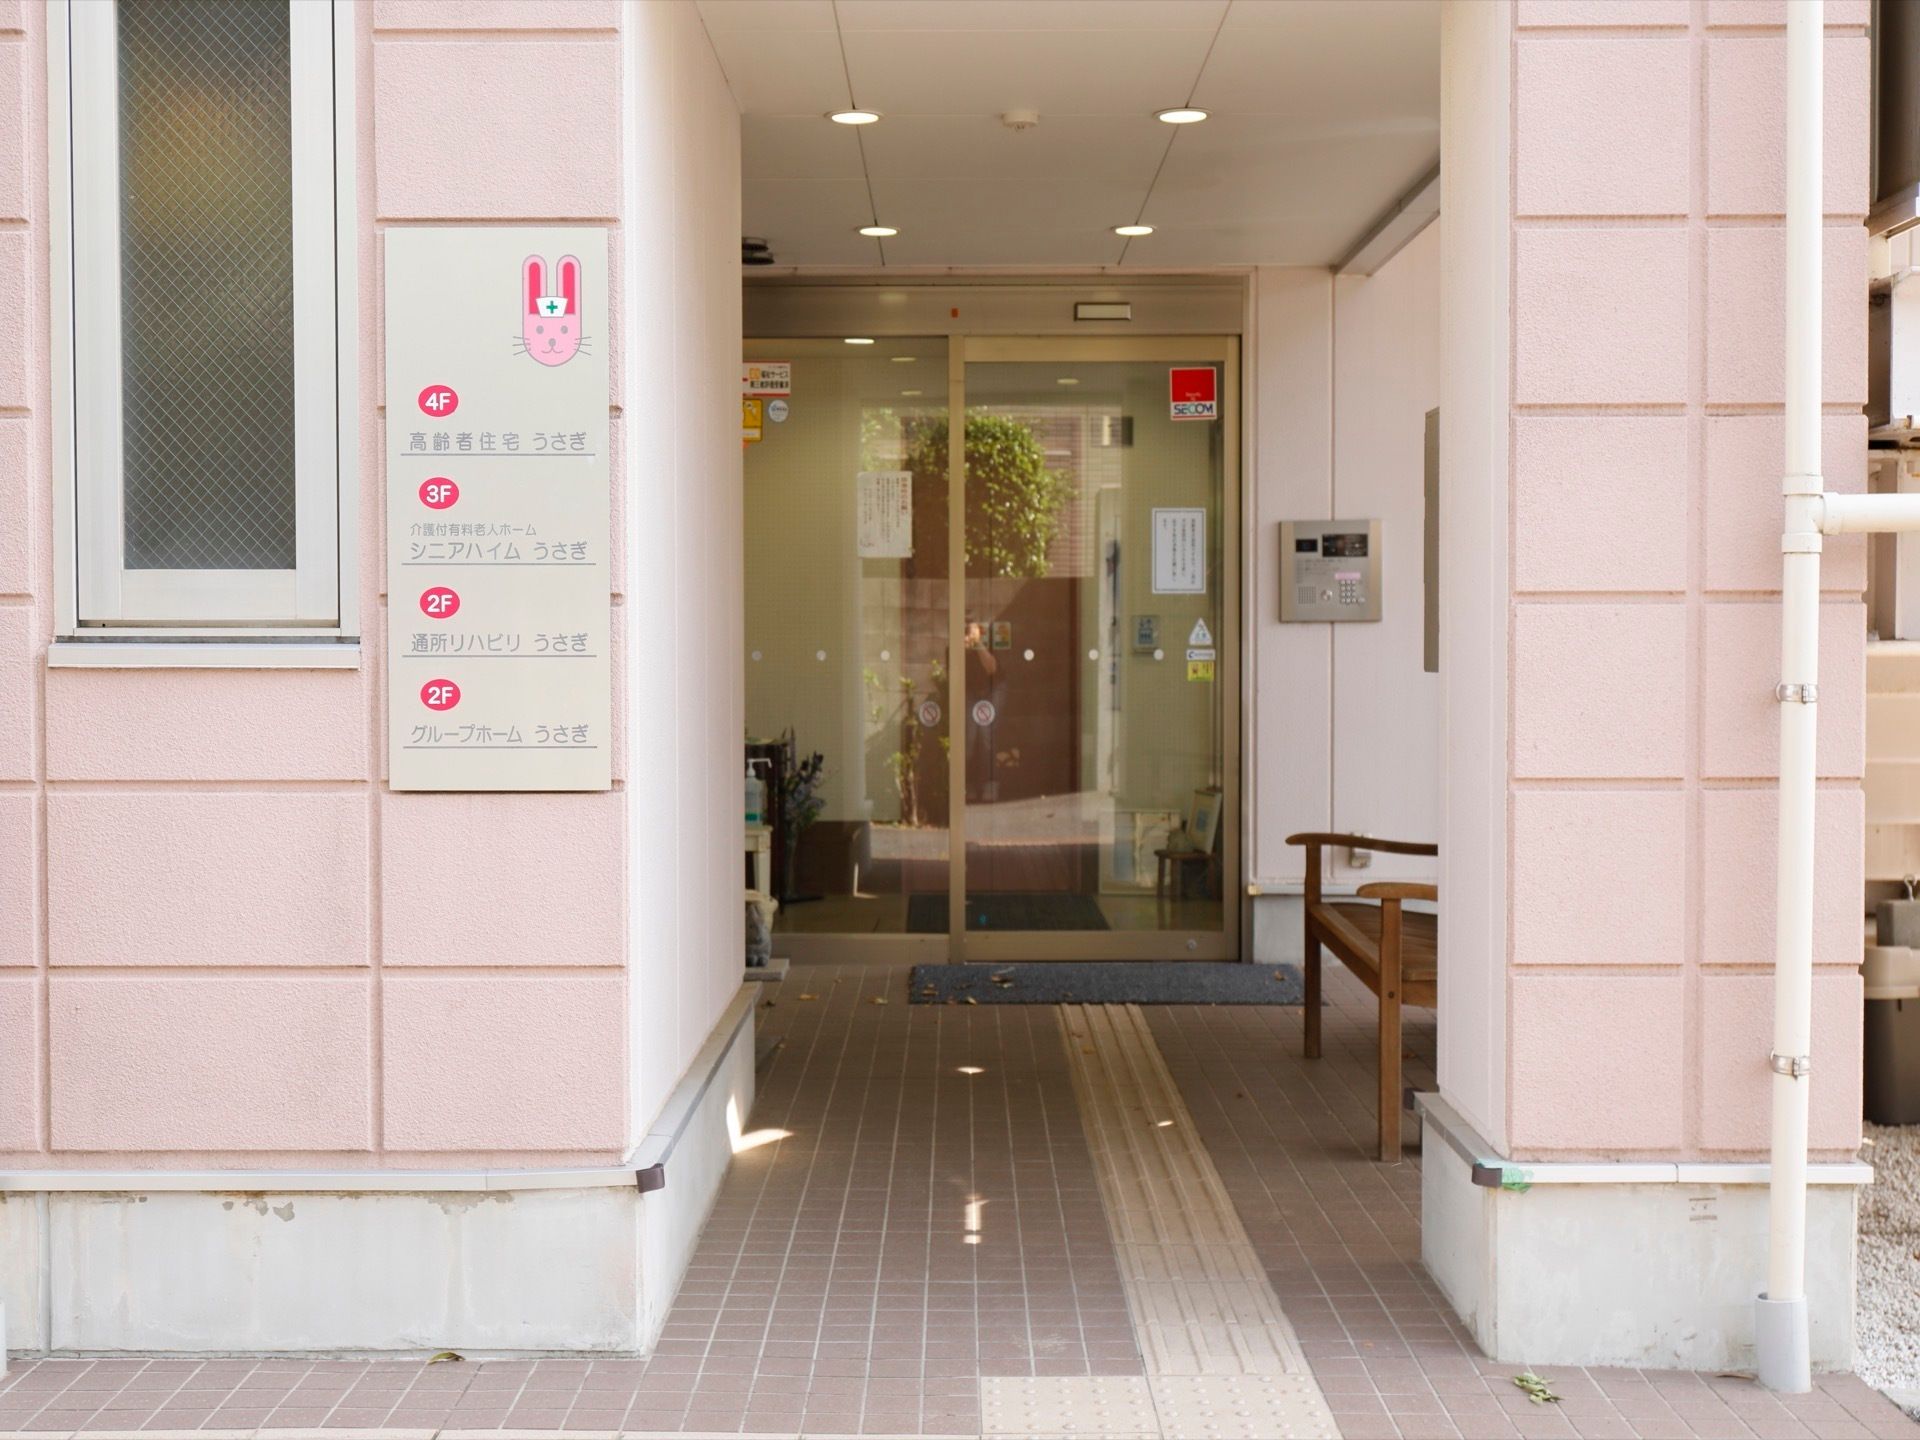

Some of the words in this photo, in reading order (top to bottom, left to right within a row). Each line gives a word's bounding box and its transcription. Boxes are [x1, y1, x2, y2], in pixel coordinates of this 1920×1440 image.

[424, 392, 451, 411] 4F
[1174, 403, 1214, 415] SECOM
[410, 432, 519, 451] 高齢者住宅
[533, 432, 587, 451] うさぎ
[426, 484, 452, 503] 3F
[410, 523, 536, 536] 介護付有料老人ホーム
[411, 542, 520, 560] シニアハイム
[534, 541, 587, 560] うさぎ
[427, 594, 453, 612] 2F
[412, 634, 519, 652] 通所リハビリ
[534, 633, 588, 652] うさぎ
[428, 686, 453, 705] 2F
[411, 724, 522, 743] グループホーム
[535, 724, 588, 743] うさぎ
